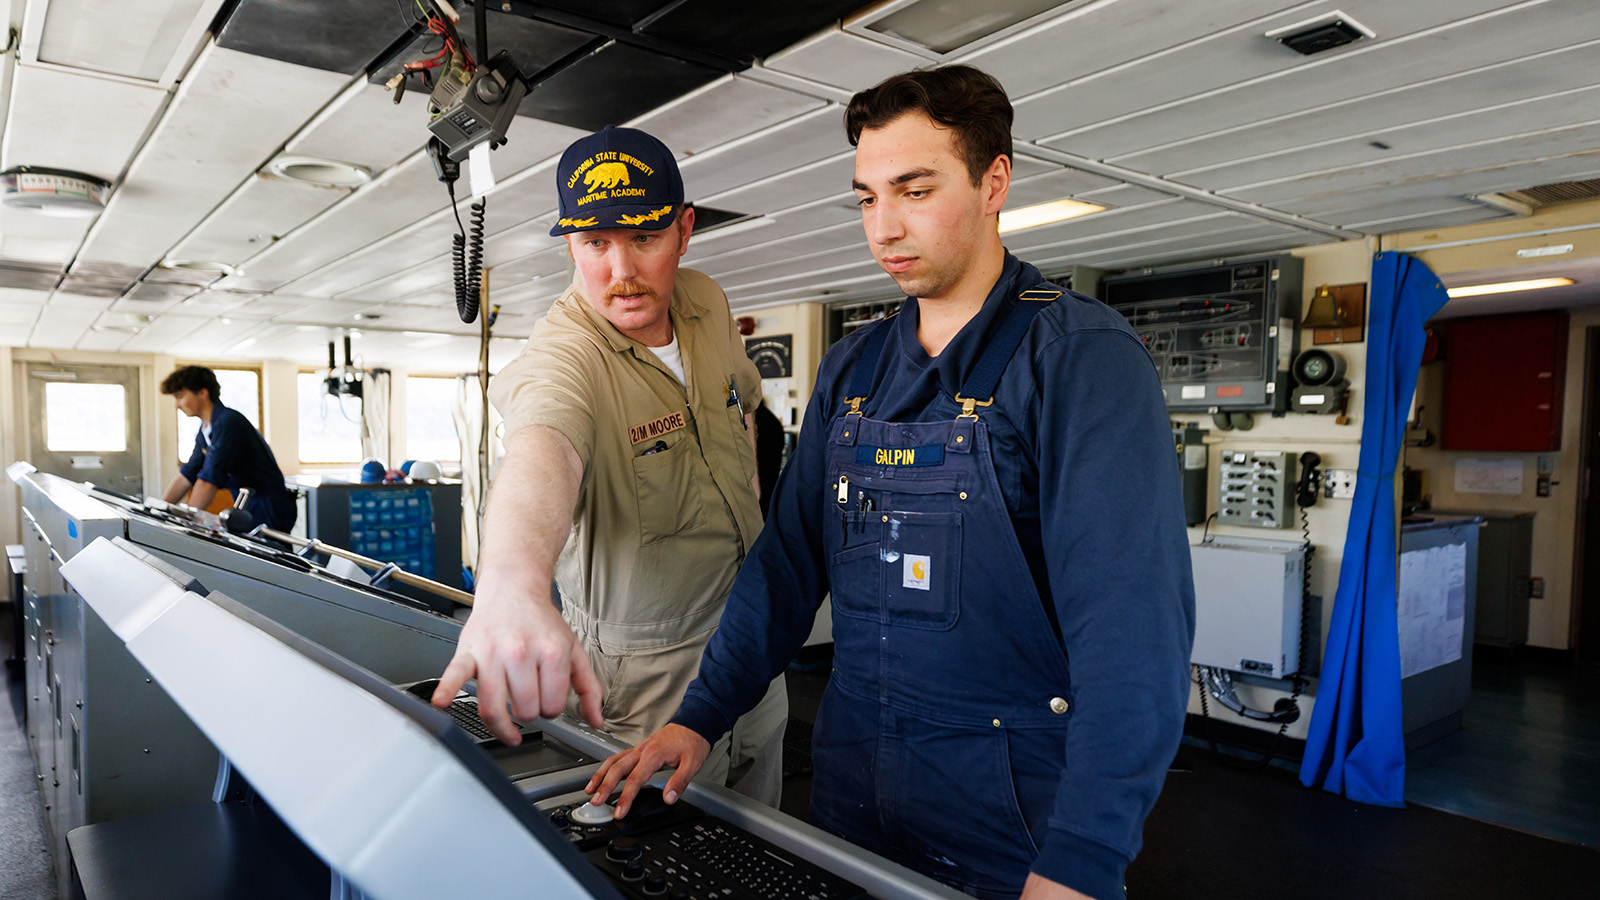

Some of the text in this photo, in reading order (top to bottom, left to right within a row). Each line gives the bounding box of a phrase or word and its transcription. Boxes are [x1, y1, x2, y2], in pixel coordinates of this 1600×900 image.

[567, 151, 654, 188] CALIFORNIA STATE UNIVERSITY
[577, 189, 646, 206] MARITIME ACADEMY
[631, 413, 684, 442] 2/M MOORE
[875, 448, 915, 465] GALPIN
